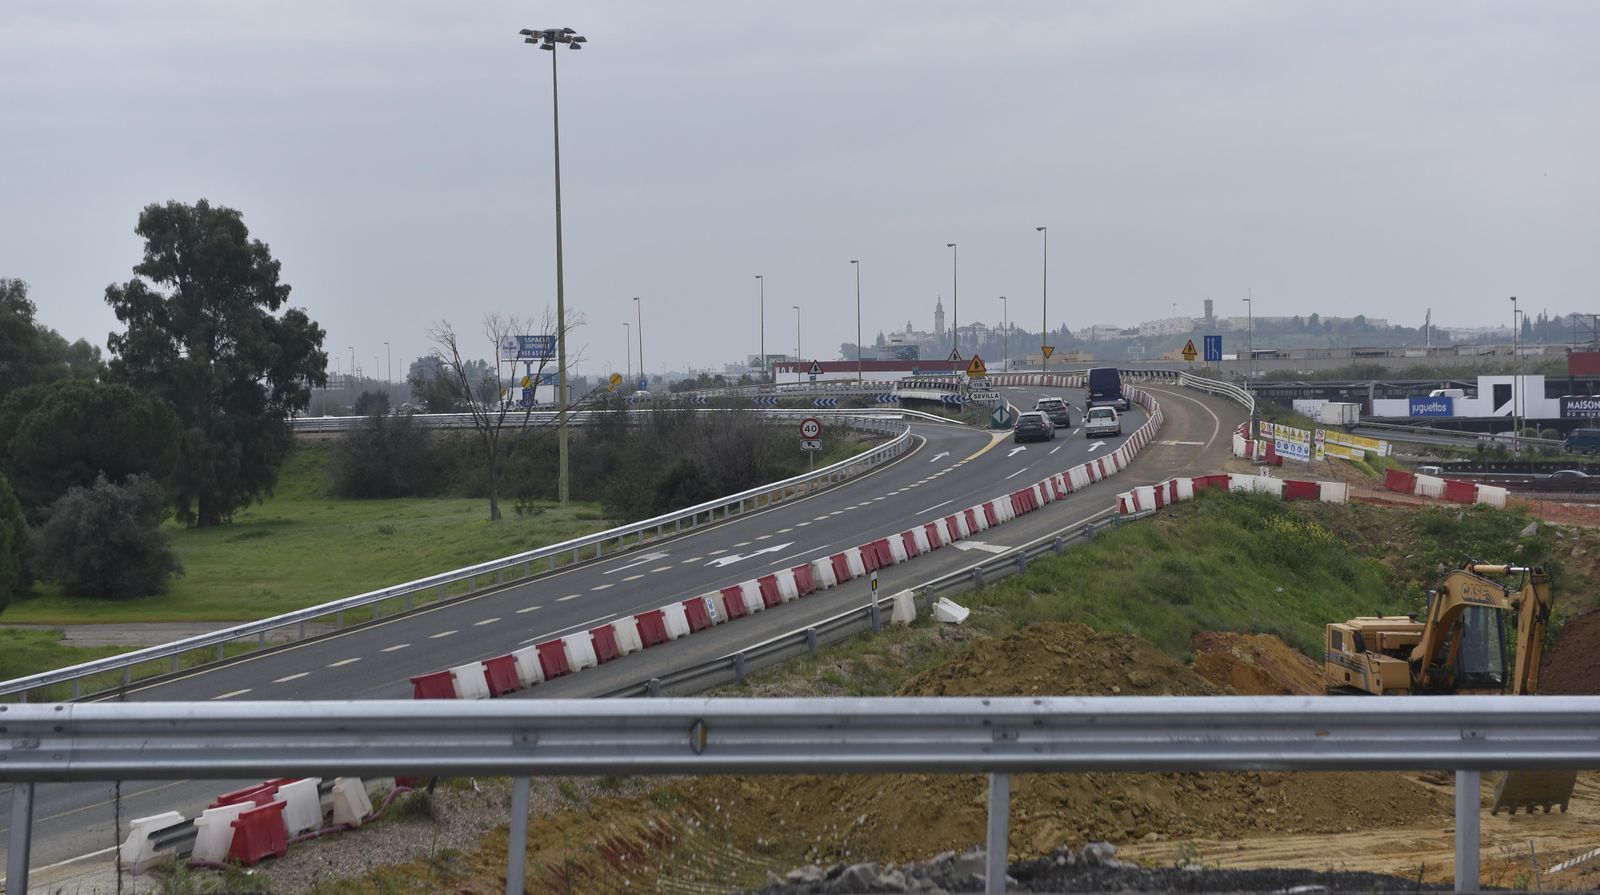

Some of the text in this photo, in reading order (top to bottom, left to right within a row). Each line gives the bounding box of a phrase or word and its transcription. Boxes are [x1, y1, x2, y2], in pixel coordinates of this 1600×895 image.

[1412, 401, 1447, 414] juguettos
[804, 424, 817, 433] 40
[1462, 583, 1488, 600] CASE
